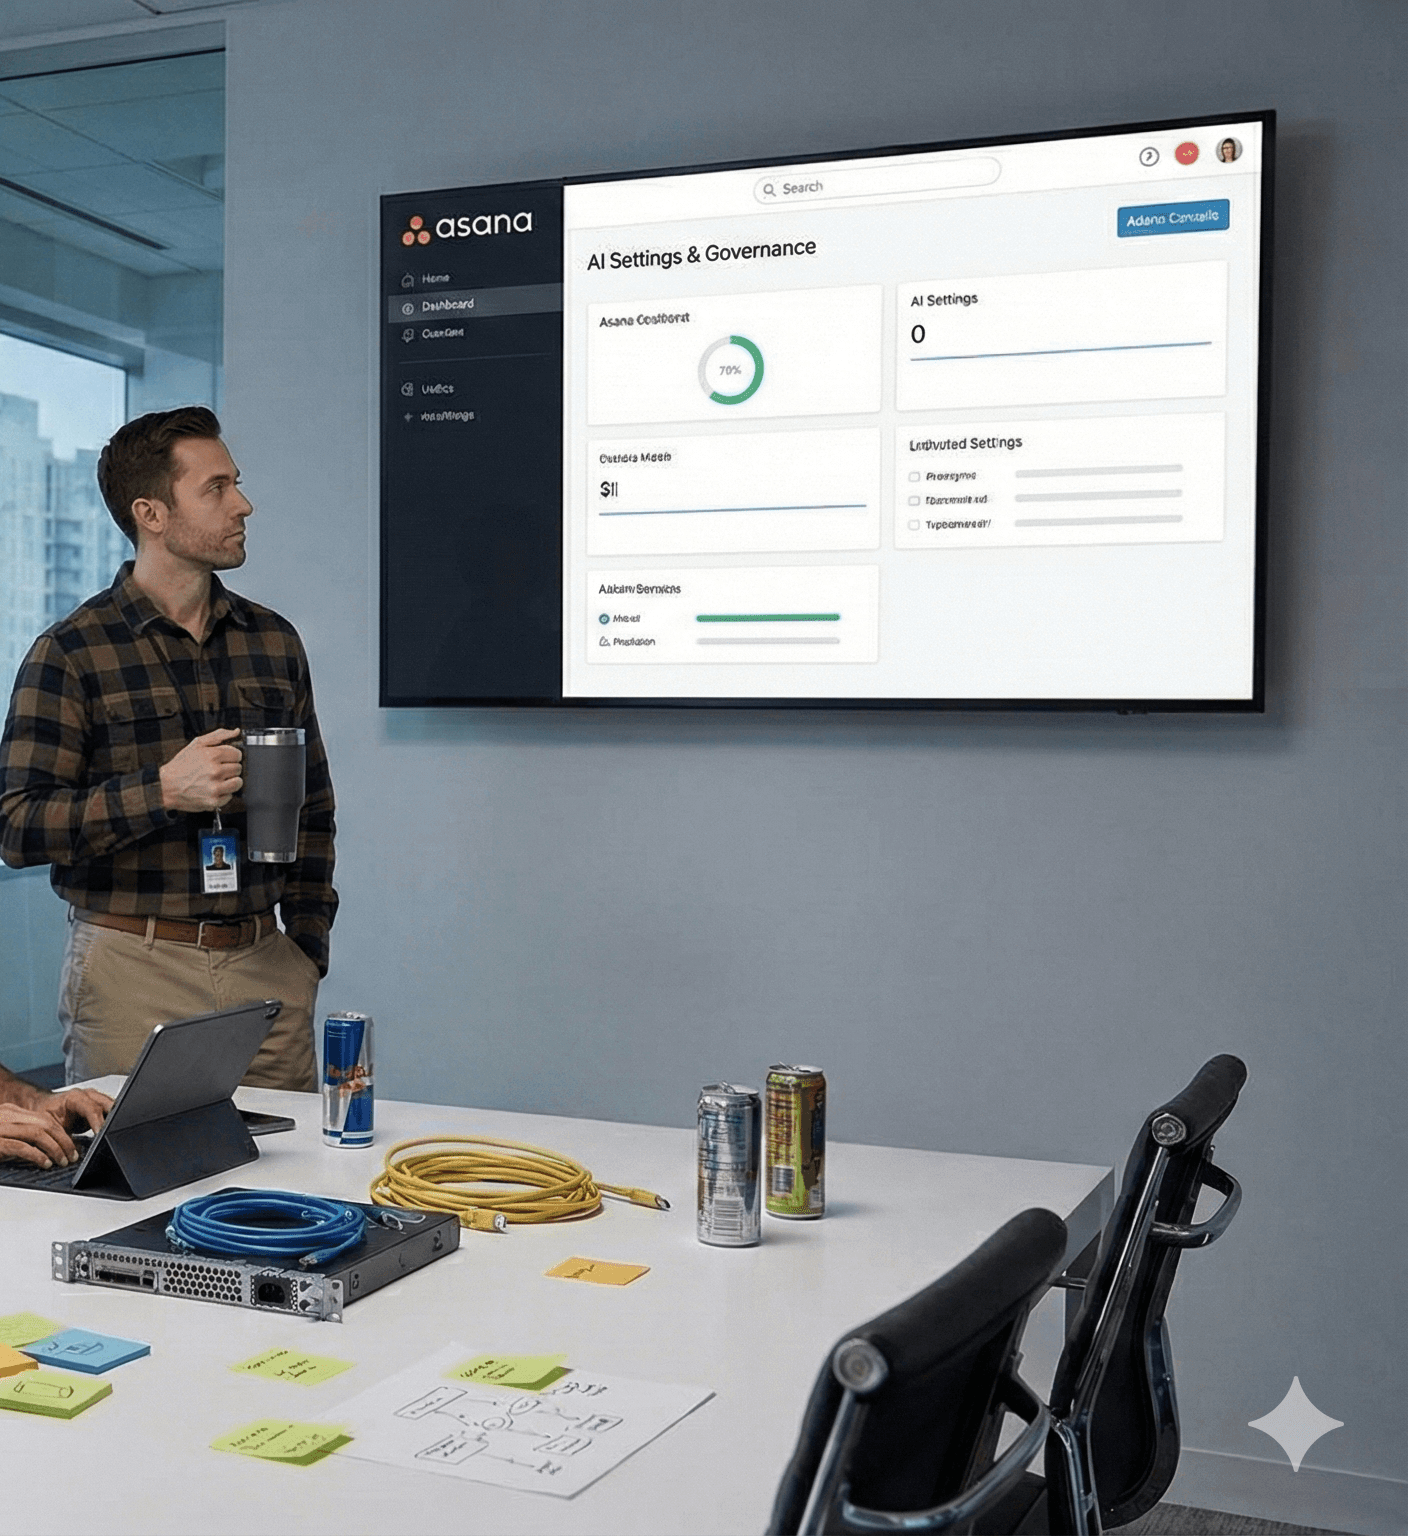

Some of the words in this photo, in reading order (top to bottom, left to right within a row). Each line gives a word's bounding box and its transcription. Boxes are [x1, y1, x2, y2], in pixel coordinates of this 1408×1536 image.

[782, 180, 823, 195] Search
[436, 212, 532, 238] asana
[587, 253, 605, 271] AI
[610, 250, 683, 269] Settings
[687, 246, 701, 263] &
[705, 241, 817, 262] Governance
[910, 295, 923, 307] AI
[927, 292, 979, 307] Settings
[911, 324, 926, 344] 0
[719, 365, 742, 376] 70%
[970, 437, 1023, 451] Settings
